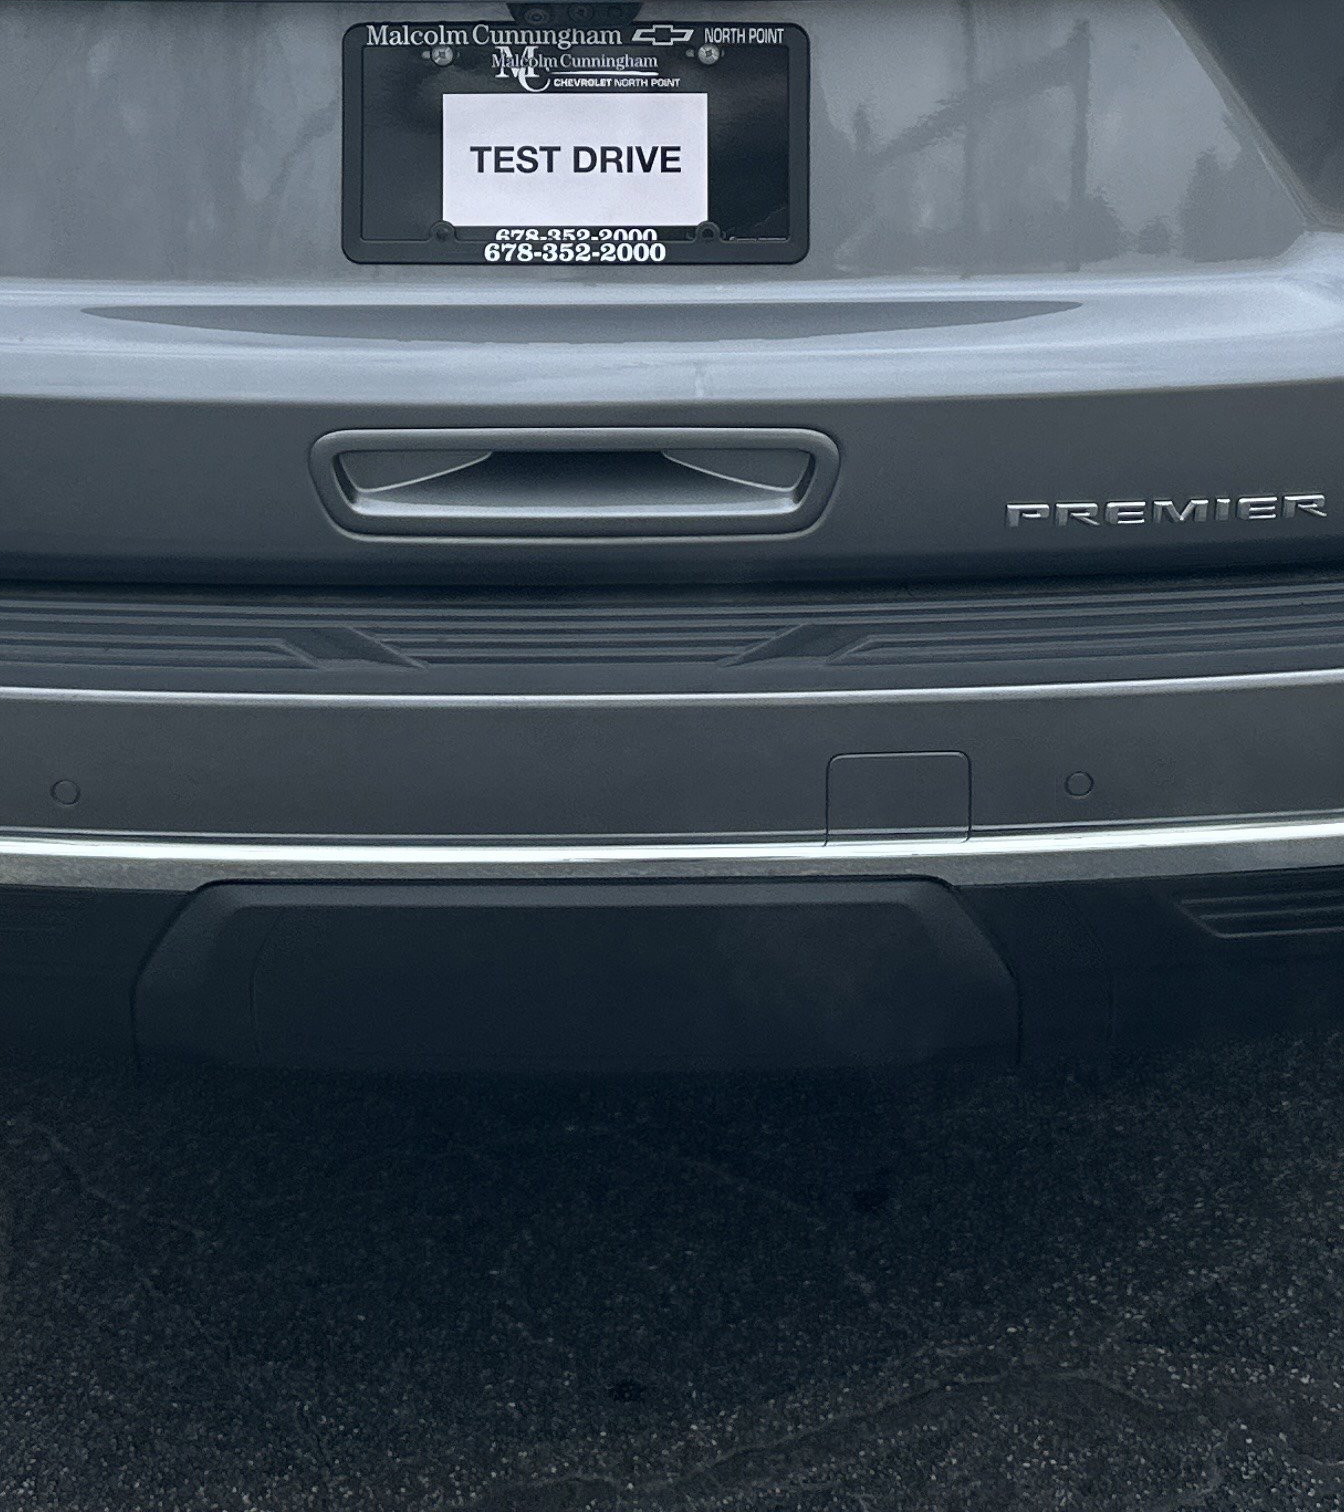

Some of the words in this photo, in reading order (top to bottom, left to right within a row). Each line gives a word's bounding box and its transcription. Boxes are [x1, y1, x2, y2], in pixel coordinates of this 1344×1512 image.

[366, 24, 469, 46] Malcolm
[472, 23, 623, 49] Cunningham
[704, 28, 746, 44] NORTH
[749, 28, 784, 44] POINT
[491, 53, 557, 69] Malcolm
[560, 53, 659, 71] Cunningham
[553, 78, 612, 88] CHEVROLET
[614, 78, 649, 88] NORTH
[651, 78, 681, 88] POINT
[470, 145, 561, 173] TEST
[573, 145, 682, 173] DRIVE
[484, 242, 666, 262] 678-352-2000
[1006, 494, 1328, 527] PREMIER
